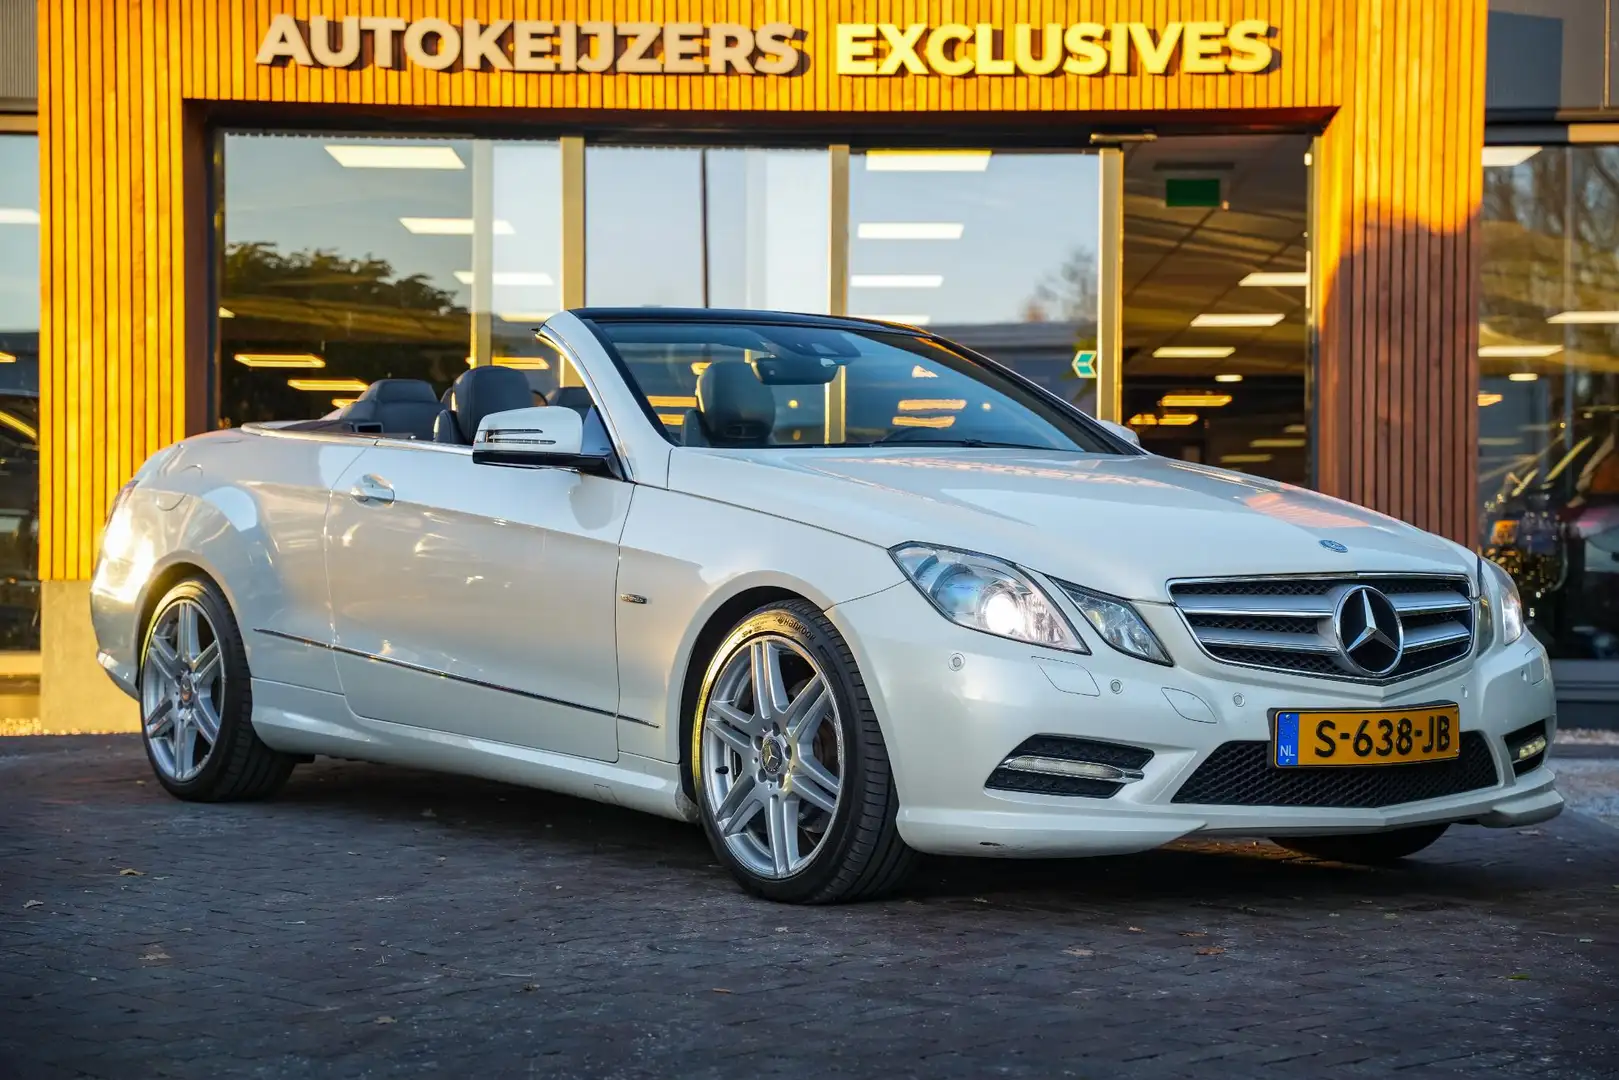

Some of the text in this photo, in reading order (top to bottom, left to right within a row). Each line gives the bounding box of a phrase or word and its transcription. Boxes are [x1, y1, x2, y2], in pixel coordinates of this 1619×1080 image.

[255, 13, 1272, 76] AUTOKEIJZERS EXCLUSIVES
[1279, 744, 1296, 757] NL
[1314, 715, 1450, 758] S-638-JB
